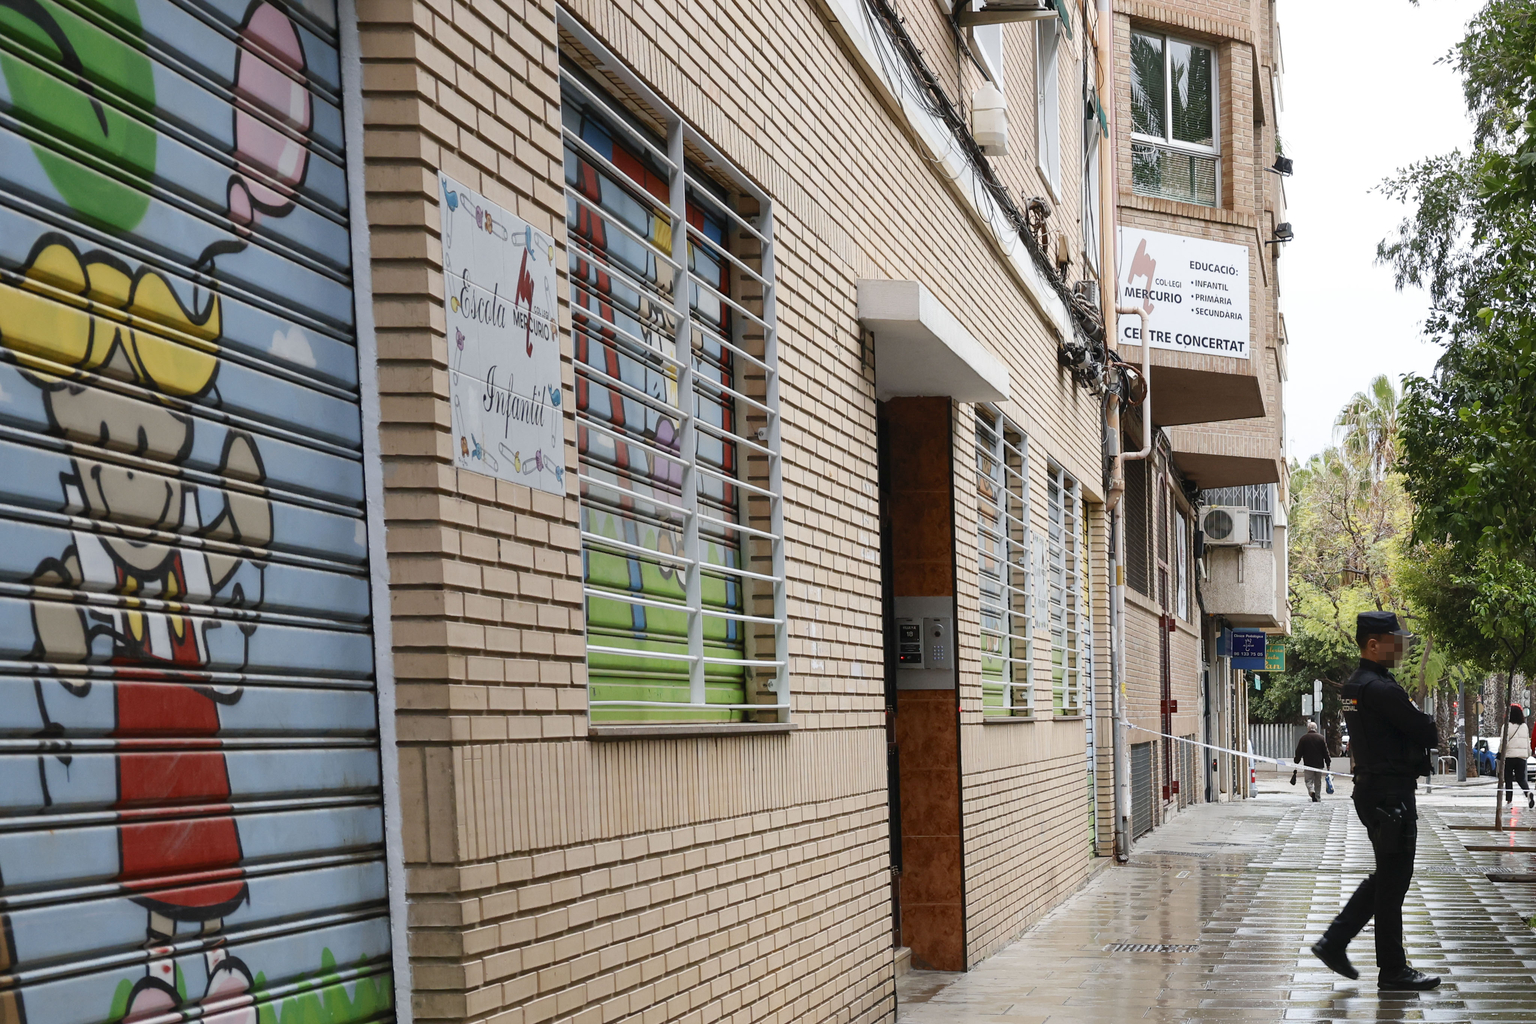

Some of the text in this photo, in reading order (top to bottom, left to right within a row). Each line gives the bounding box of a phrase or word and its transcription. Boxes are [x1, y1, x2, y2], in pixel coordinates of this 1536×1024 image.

[1189, 260, 1239, 276] EDUCACIÓ:
[1195, 280, 1229, 291] INFANTIL
[460, 268, 506, 330] Escola
[1124, 287, 1182, 304] MERCURIO
[1195, 294, 1232, 305] PRIMÀRIA
[1195, 307, 1243, 320] SECUNDÀRIA
[513, 309, 550, 341] MERCURIO
[1124, 327, 1245, 352] CETRE CONCERTAT
[483, 365, 545, 439] Infantil
